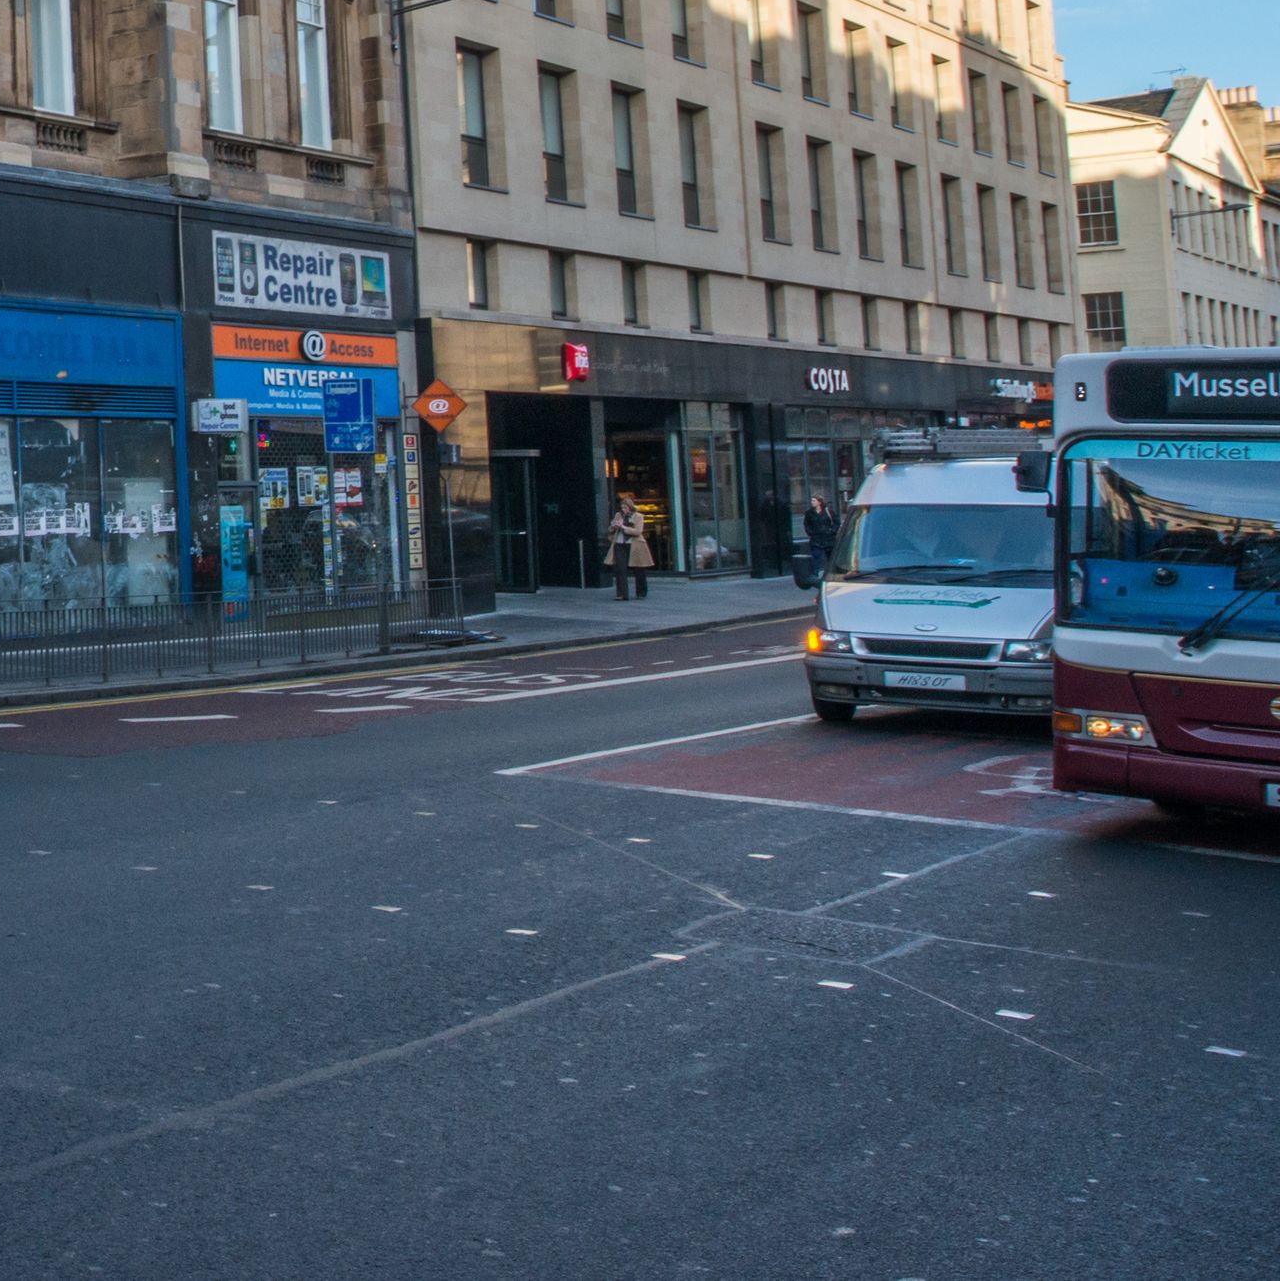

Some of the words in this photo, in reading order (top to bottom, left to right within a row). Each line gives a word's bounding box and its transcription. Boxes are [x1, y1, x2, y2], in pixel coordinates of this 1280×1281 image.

[263, 244, 335, 279] Repair
[264, 275, 337, 307] Centre
[234, 333, 289, 353] Internet
[329, 339, 374, 358] Access
[269, 389, 289, 398] Media
[810, 367, 850, 394] COSTA
[1173, 371, 1280, 398] Mussel
[1137, 442, 1252, 460] DAYticket
